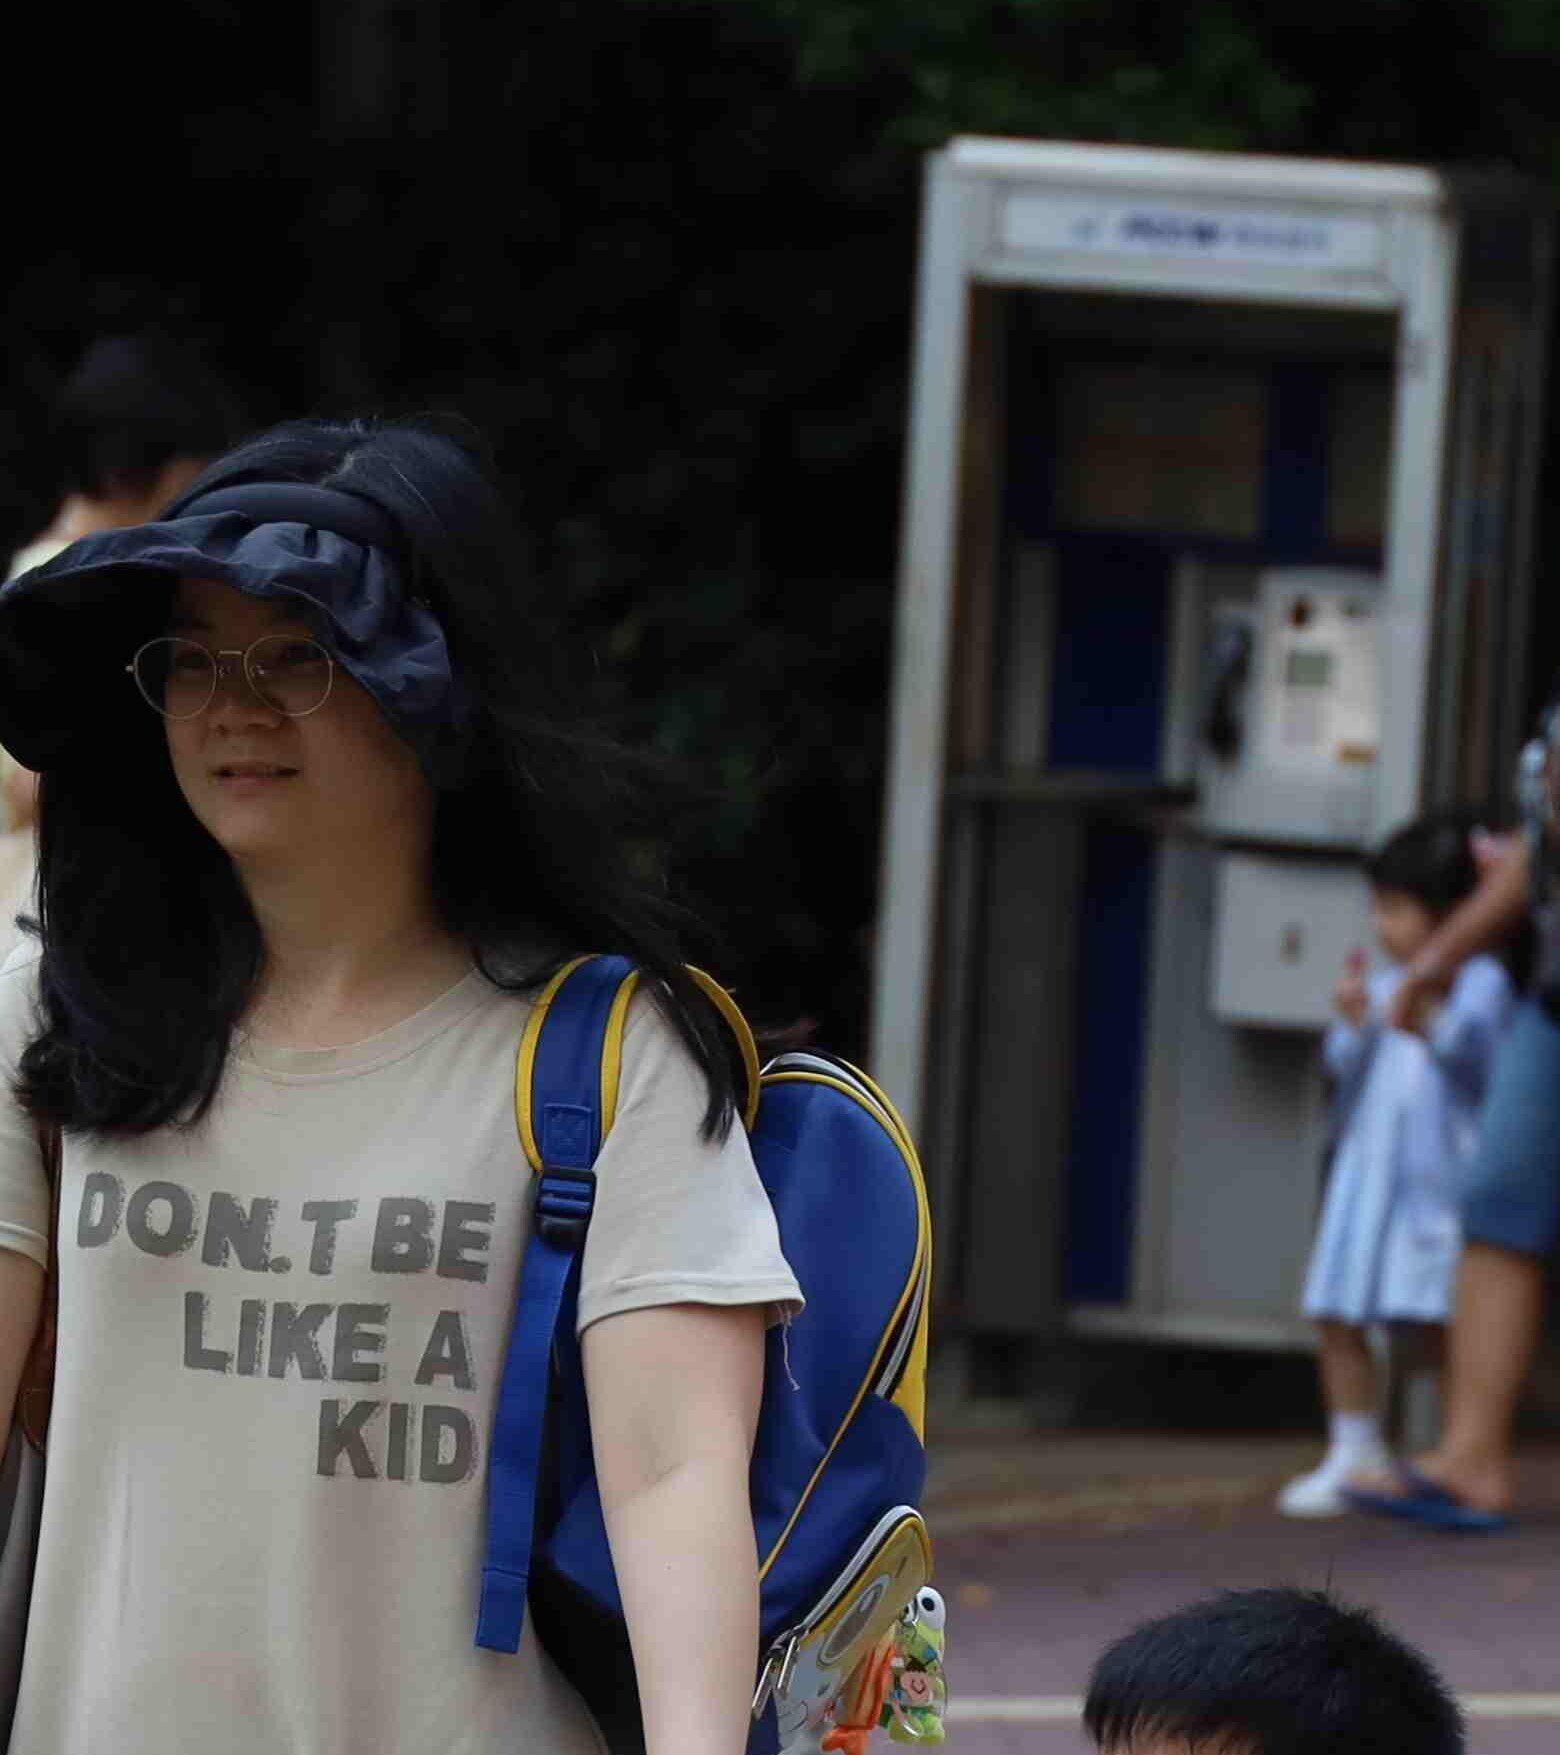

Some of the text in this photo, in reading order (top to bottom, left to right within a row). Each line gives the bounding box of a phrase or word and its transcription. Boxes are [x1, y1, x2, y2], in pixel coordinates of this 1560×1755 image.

[370, 1195, 497, 1284] BE
[183, 1290, 477, 1391] LIKE A
[316, 1399, 480, 1485] KID
